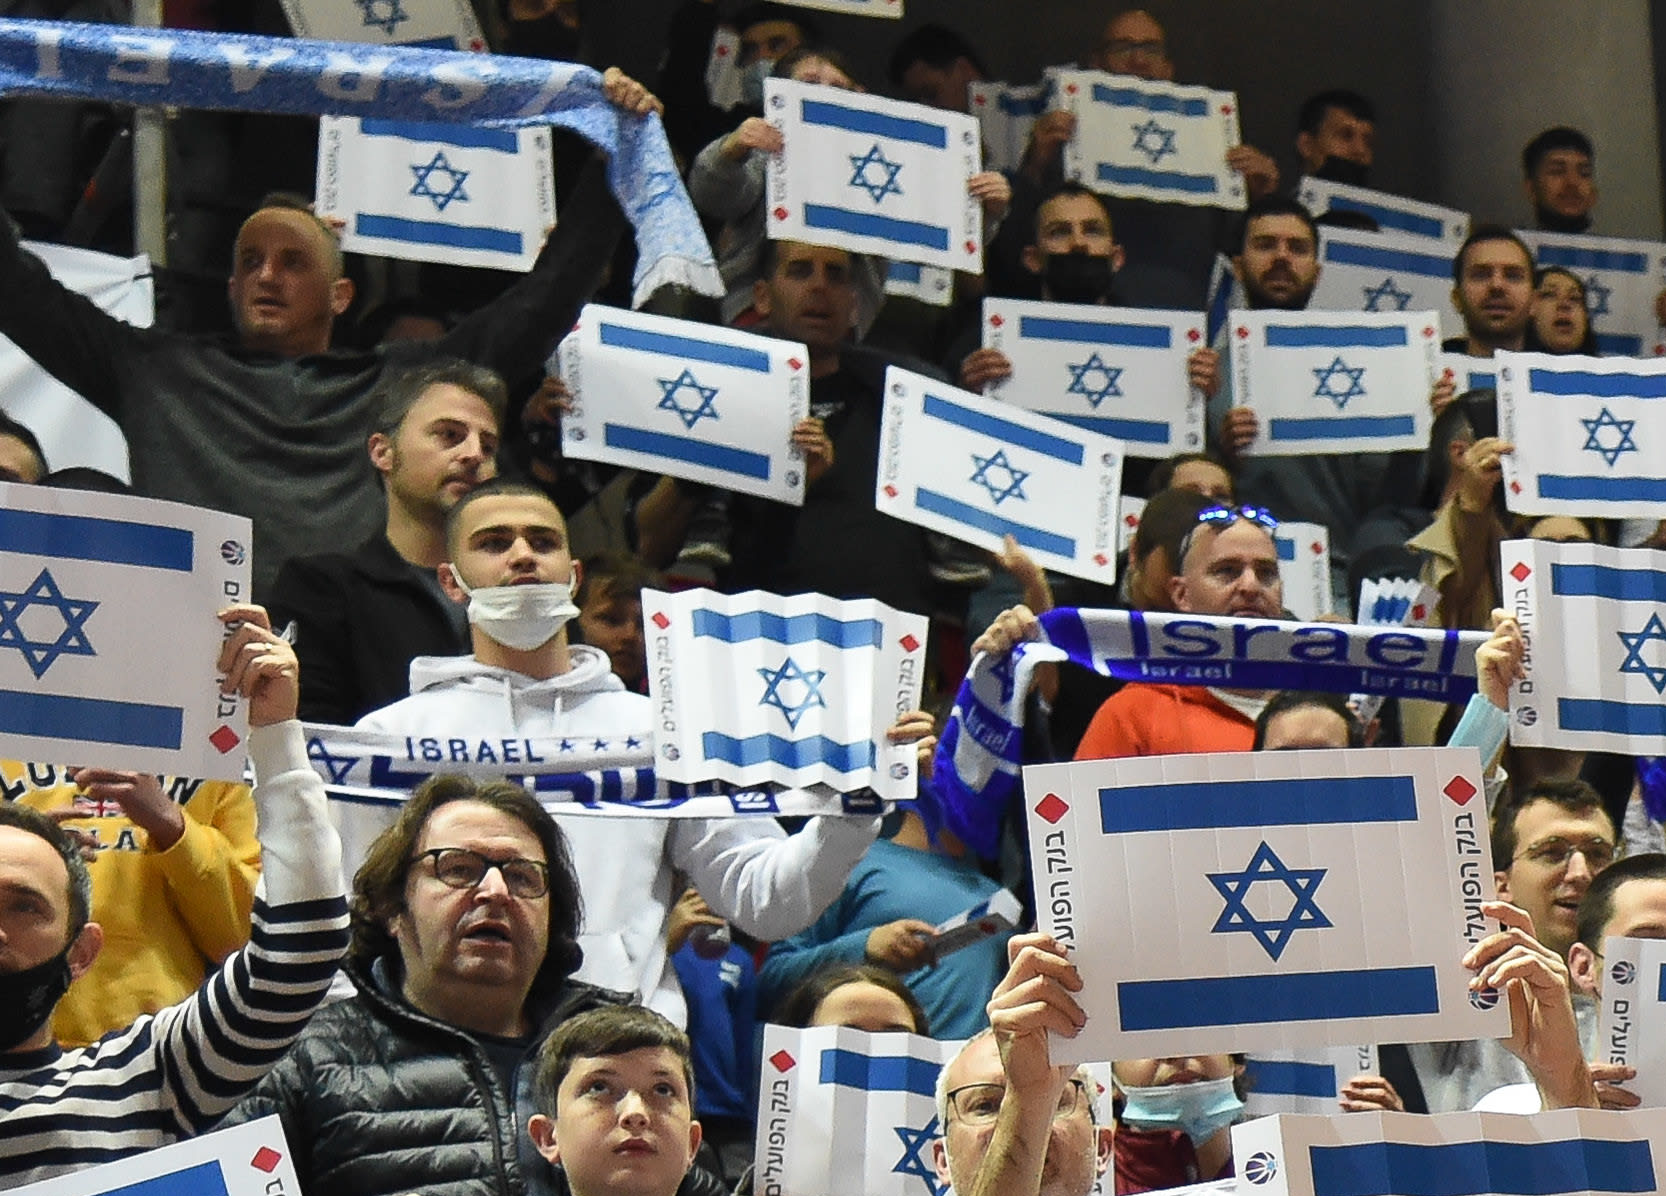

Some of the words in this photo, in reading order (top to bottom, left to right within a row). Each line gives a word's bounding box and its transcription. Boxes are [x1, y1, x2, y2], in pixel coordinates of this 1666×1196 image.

[1129, 609, 1461, 681] Israel
[1140, 662, 1234, 682] Israel
[1362, 668, 1451, 694] Israel
[216, 678, 238, 719] בנ
[405, 736, 545, 764] ISRAEL
[1045, 830, 1073, 874] בנק
[1454, 811, 1482, 855] בנק
[1050, 880, 1076, 951] הפוע
[1459, 862, 1488, 944] הפועלי
[771, 1080, 791, 1113] בנק
